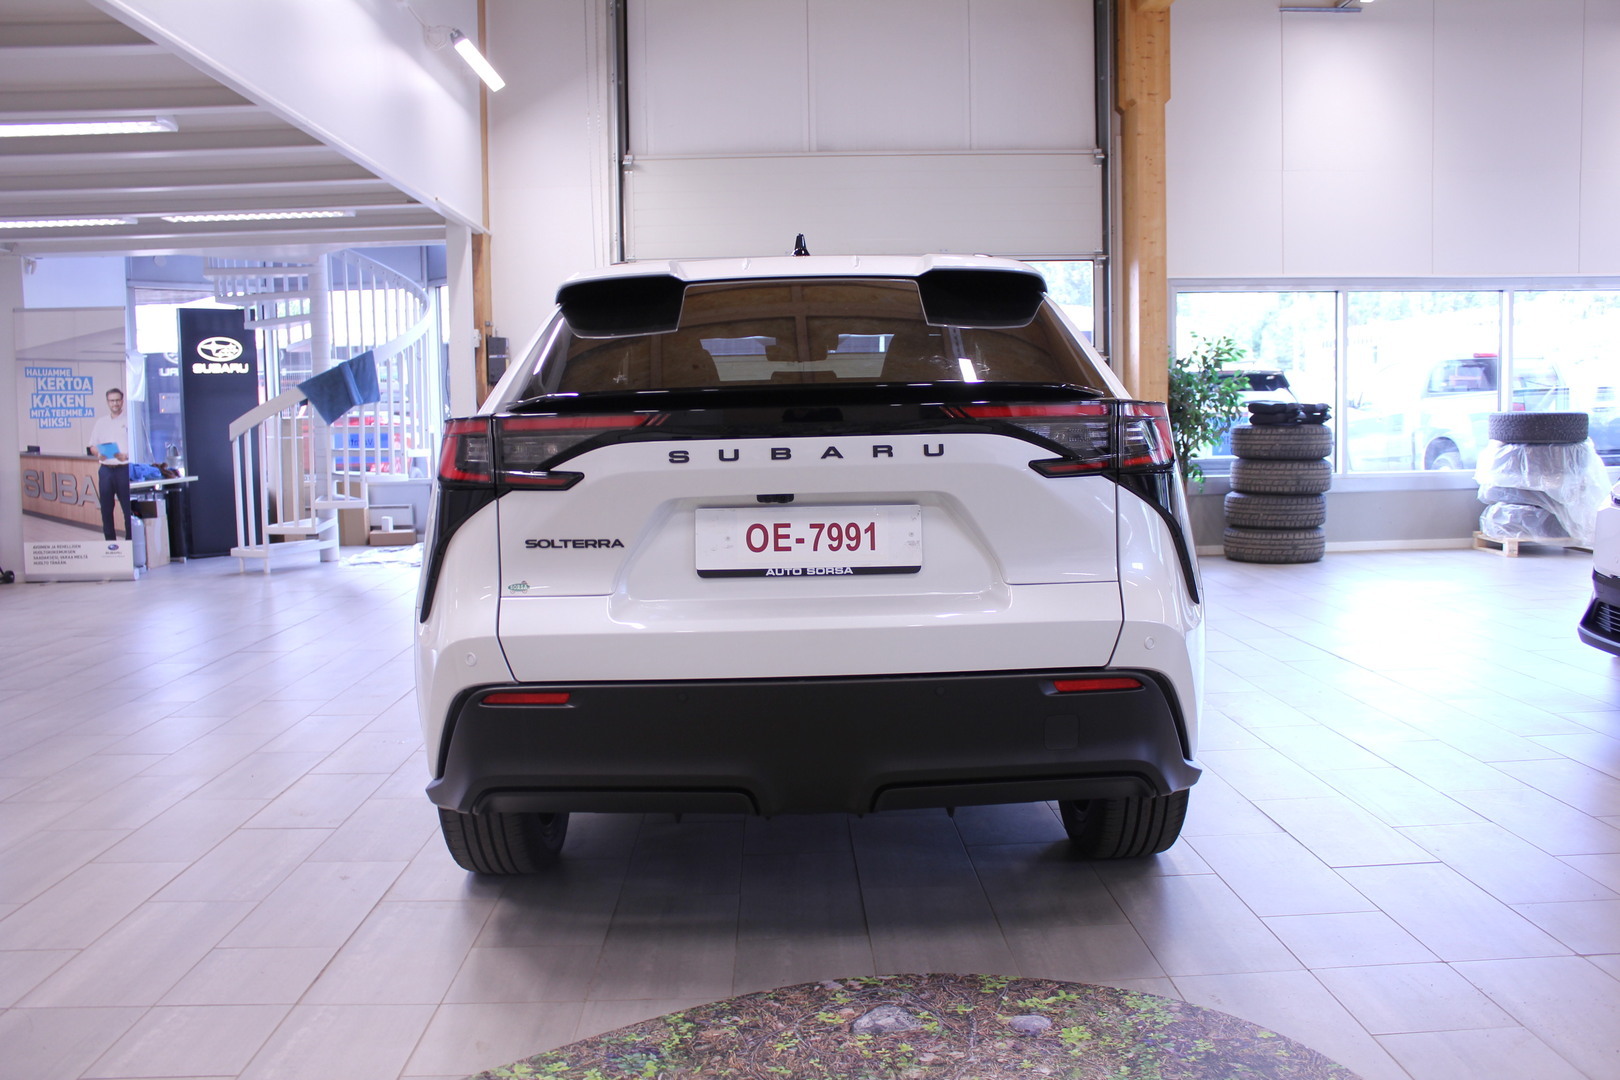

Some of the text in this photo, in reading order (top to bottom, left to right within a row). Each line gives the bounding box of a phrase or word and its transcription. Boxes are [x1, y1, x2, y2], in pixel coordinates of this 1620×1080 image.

[26, 368, 71, 376] HALUAMME
[192, 363, 249, 374] SUBARU
[37, 377, 92, 390] KERTOA
[32, 394, 85, 408] KAIKEN
[31, 408, 93, 418] MITÄ TEEMME JA
[40, 418, 70, 428] MIKSI.
[668, 443, 945, 464] SUBARU
[745, 522, 877, 553] OE-7991
[525, 538, 625, 549] SOLTERRA
[766, 568, 802, 576] AUTO
